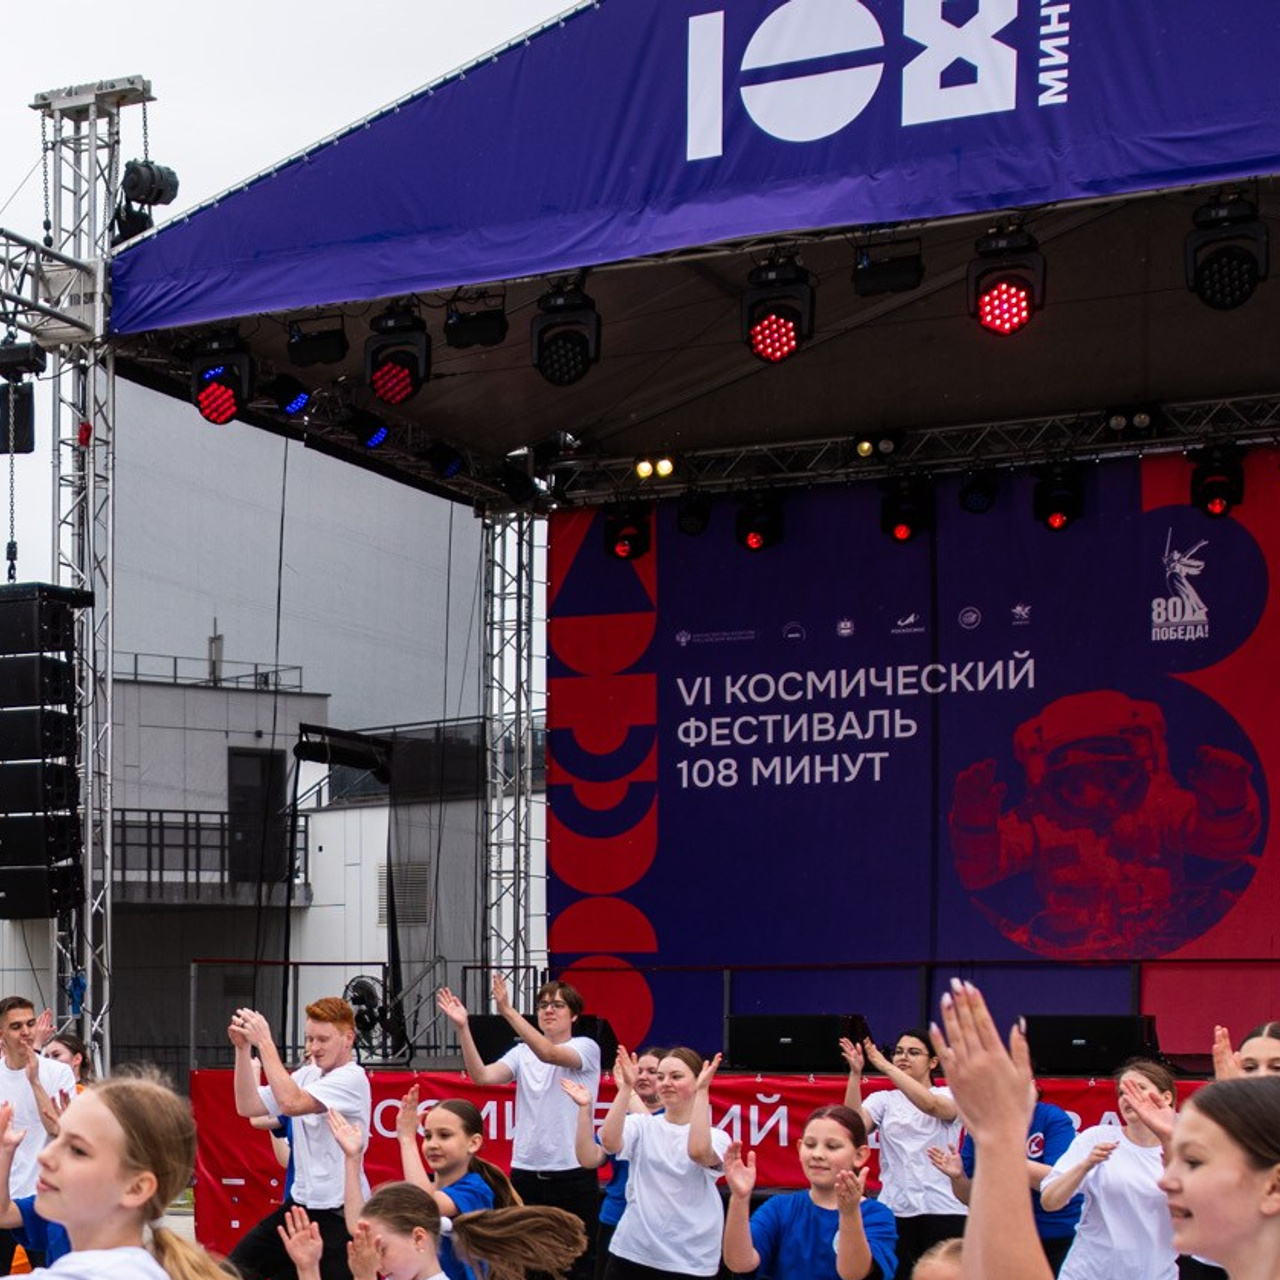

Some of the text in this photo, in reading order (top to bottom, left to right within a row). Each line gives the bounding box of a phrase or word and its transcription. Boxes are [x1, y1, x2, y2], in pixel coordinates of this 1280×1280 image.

[1038, 0, 1070, 107] МИН
[687, 0, 1019, 161] 108
[1151, 596, 1183, 623] 80
[1151, 624, 1209, 641] ПОБЕДА!
[676, 650, 1035, 706] VI КОСМИЧЕСКИЙ
[677, 708, 918, 748] ФЕСТИВАЛЬ
[676, 752, 890, 788] 108 МИНУТ
